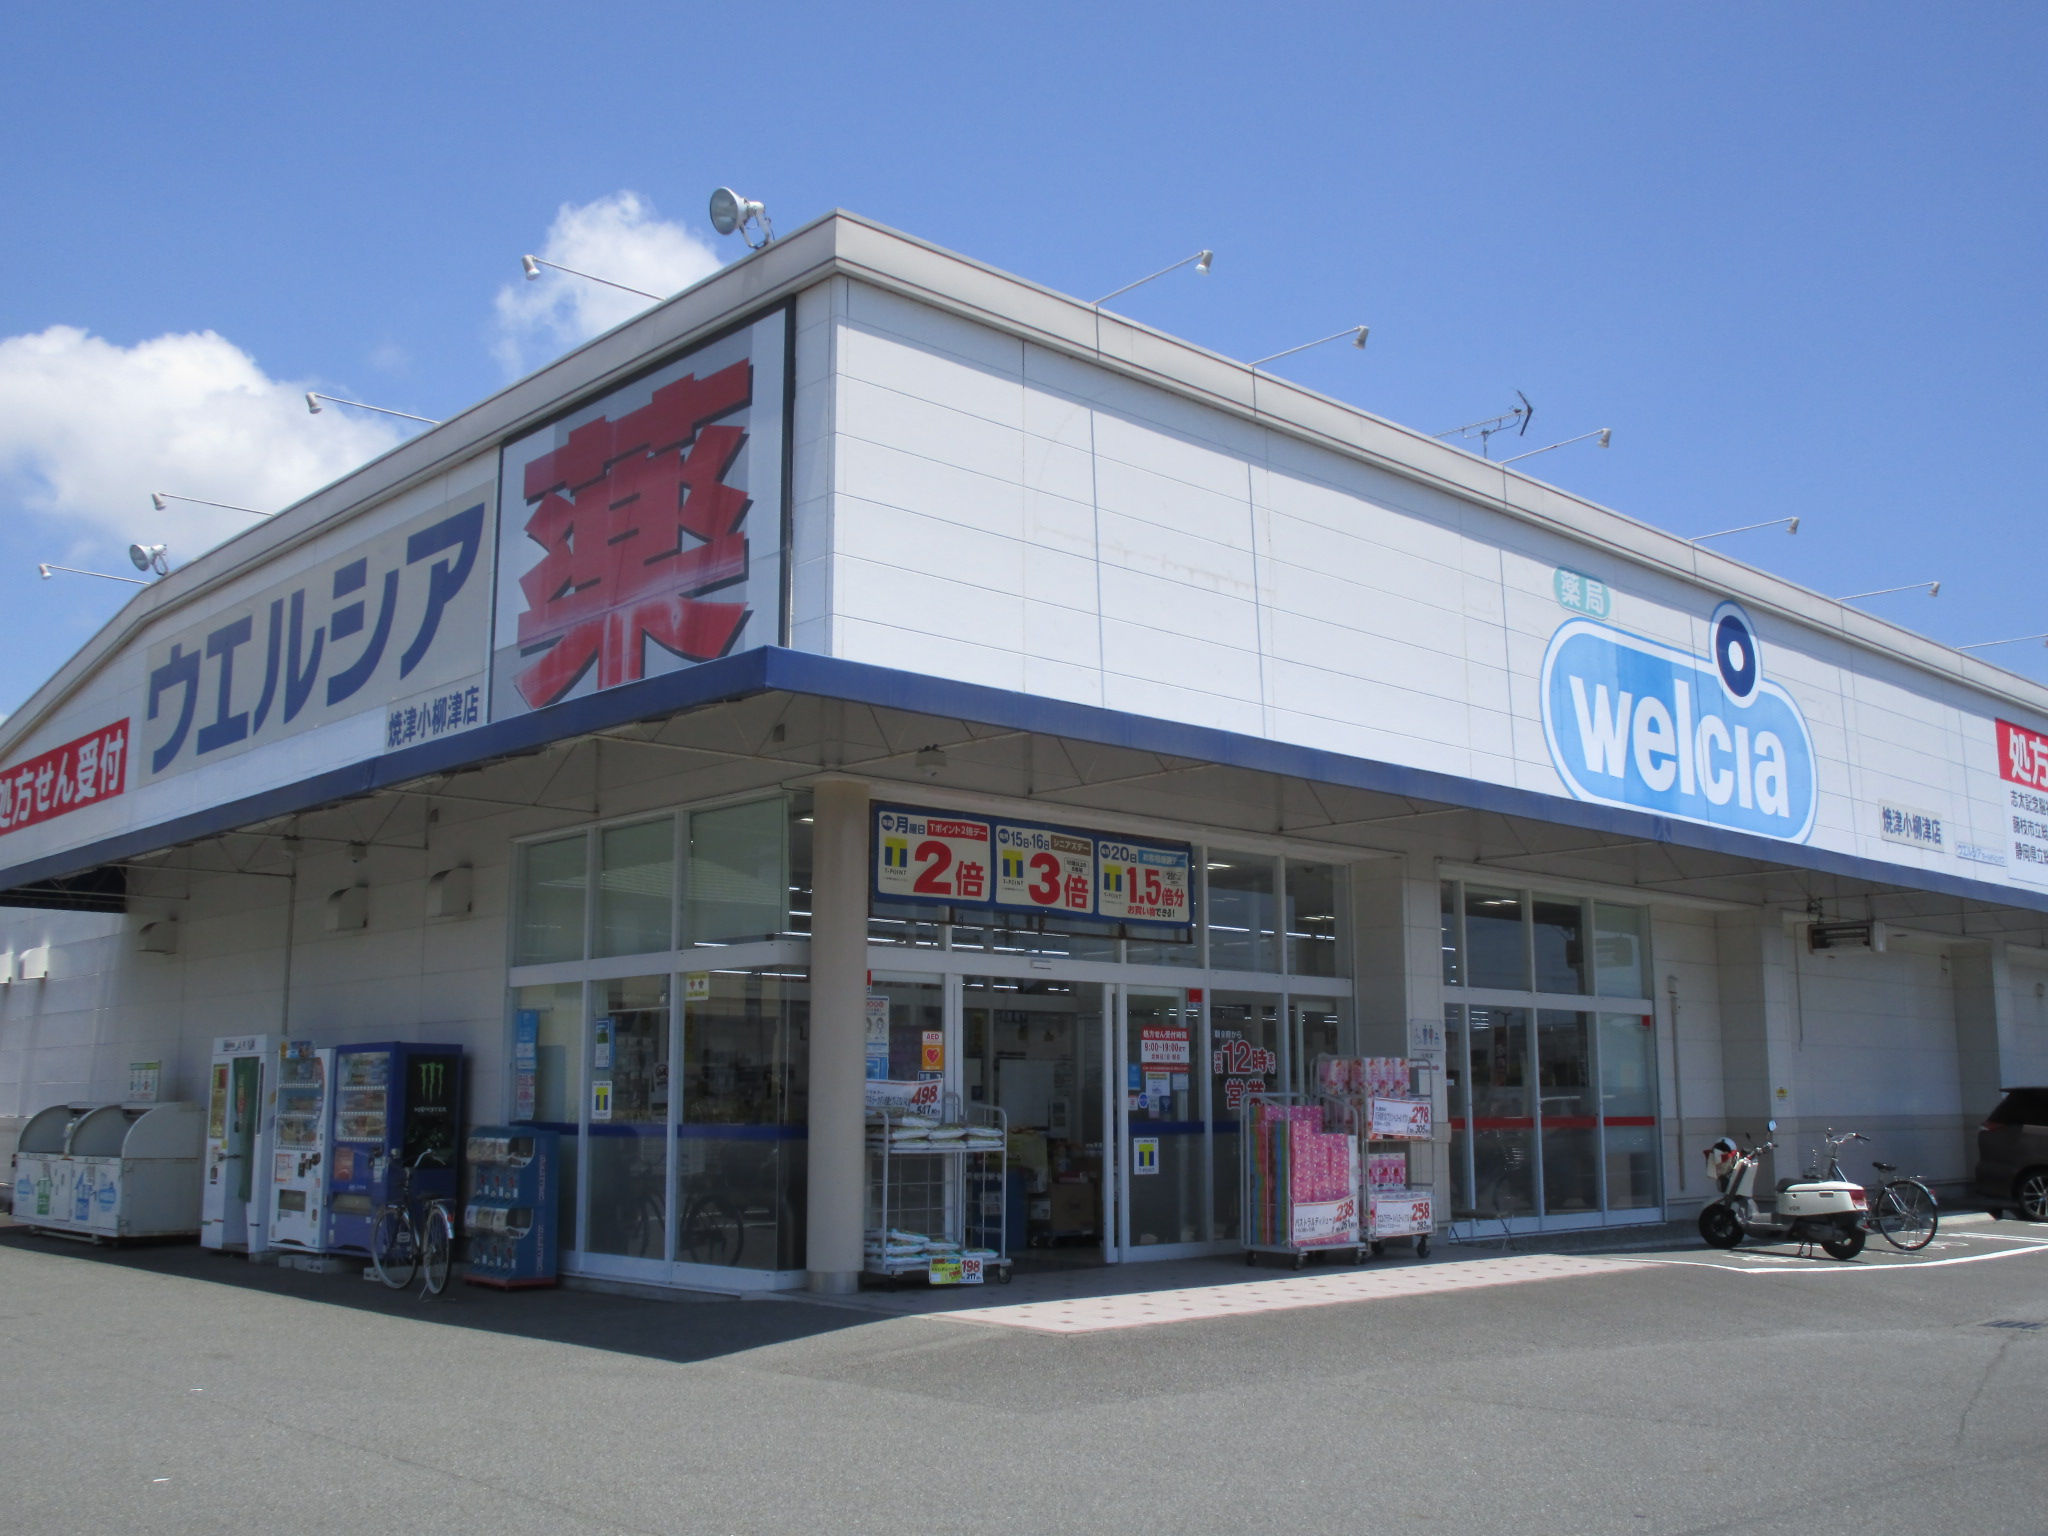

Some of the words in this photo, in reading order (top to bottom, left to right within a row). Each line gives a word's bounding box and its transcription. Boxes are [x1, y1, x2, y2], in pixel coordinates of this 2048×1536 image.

[511, 357, 754, 710] 薬
[1560, 570, 1604, 614] 薬局
[147, 502, 485, 775] ウエルシア
[388, 685, 480, 748] 焼津小柳津店
[1568, 675, 1790, 819] welcia
[0, 729, 124, 828] 処方せん受付
[895, 816, 926, 834] 月曜日
[930, 823, 987, 837] Tポイント2倍デー
[1882, 805, 1942, 846] 焼津小柳津店
[913, 841, 985, 897] 2倍
[1111, 845, 1137, 863] 20日
[1028, 852, 1089, 909] 3倍
[911, 1085, 938, 1104] 498
[1410, 1106, 1429, 1124] 278
[1335, 1200, 1354, 1222] 238
[1411, 1202, 1430, 1221] 258
[961, 1260, 981, 1272] 198
